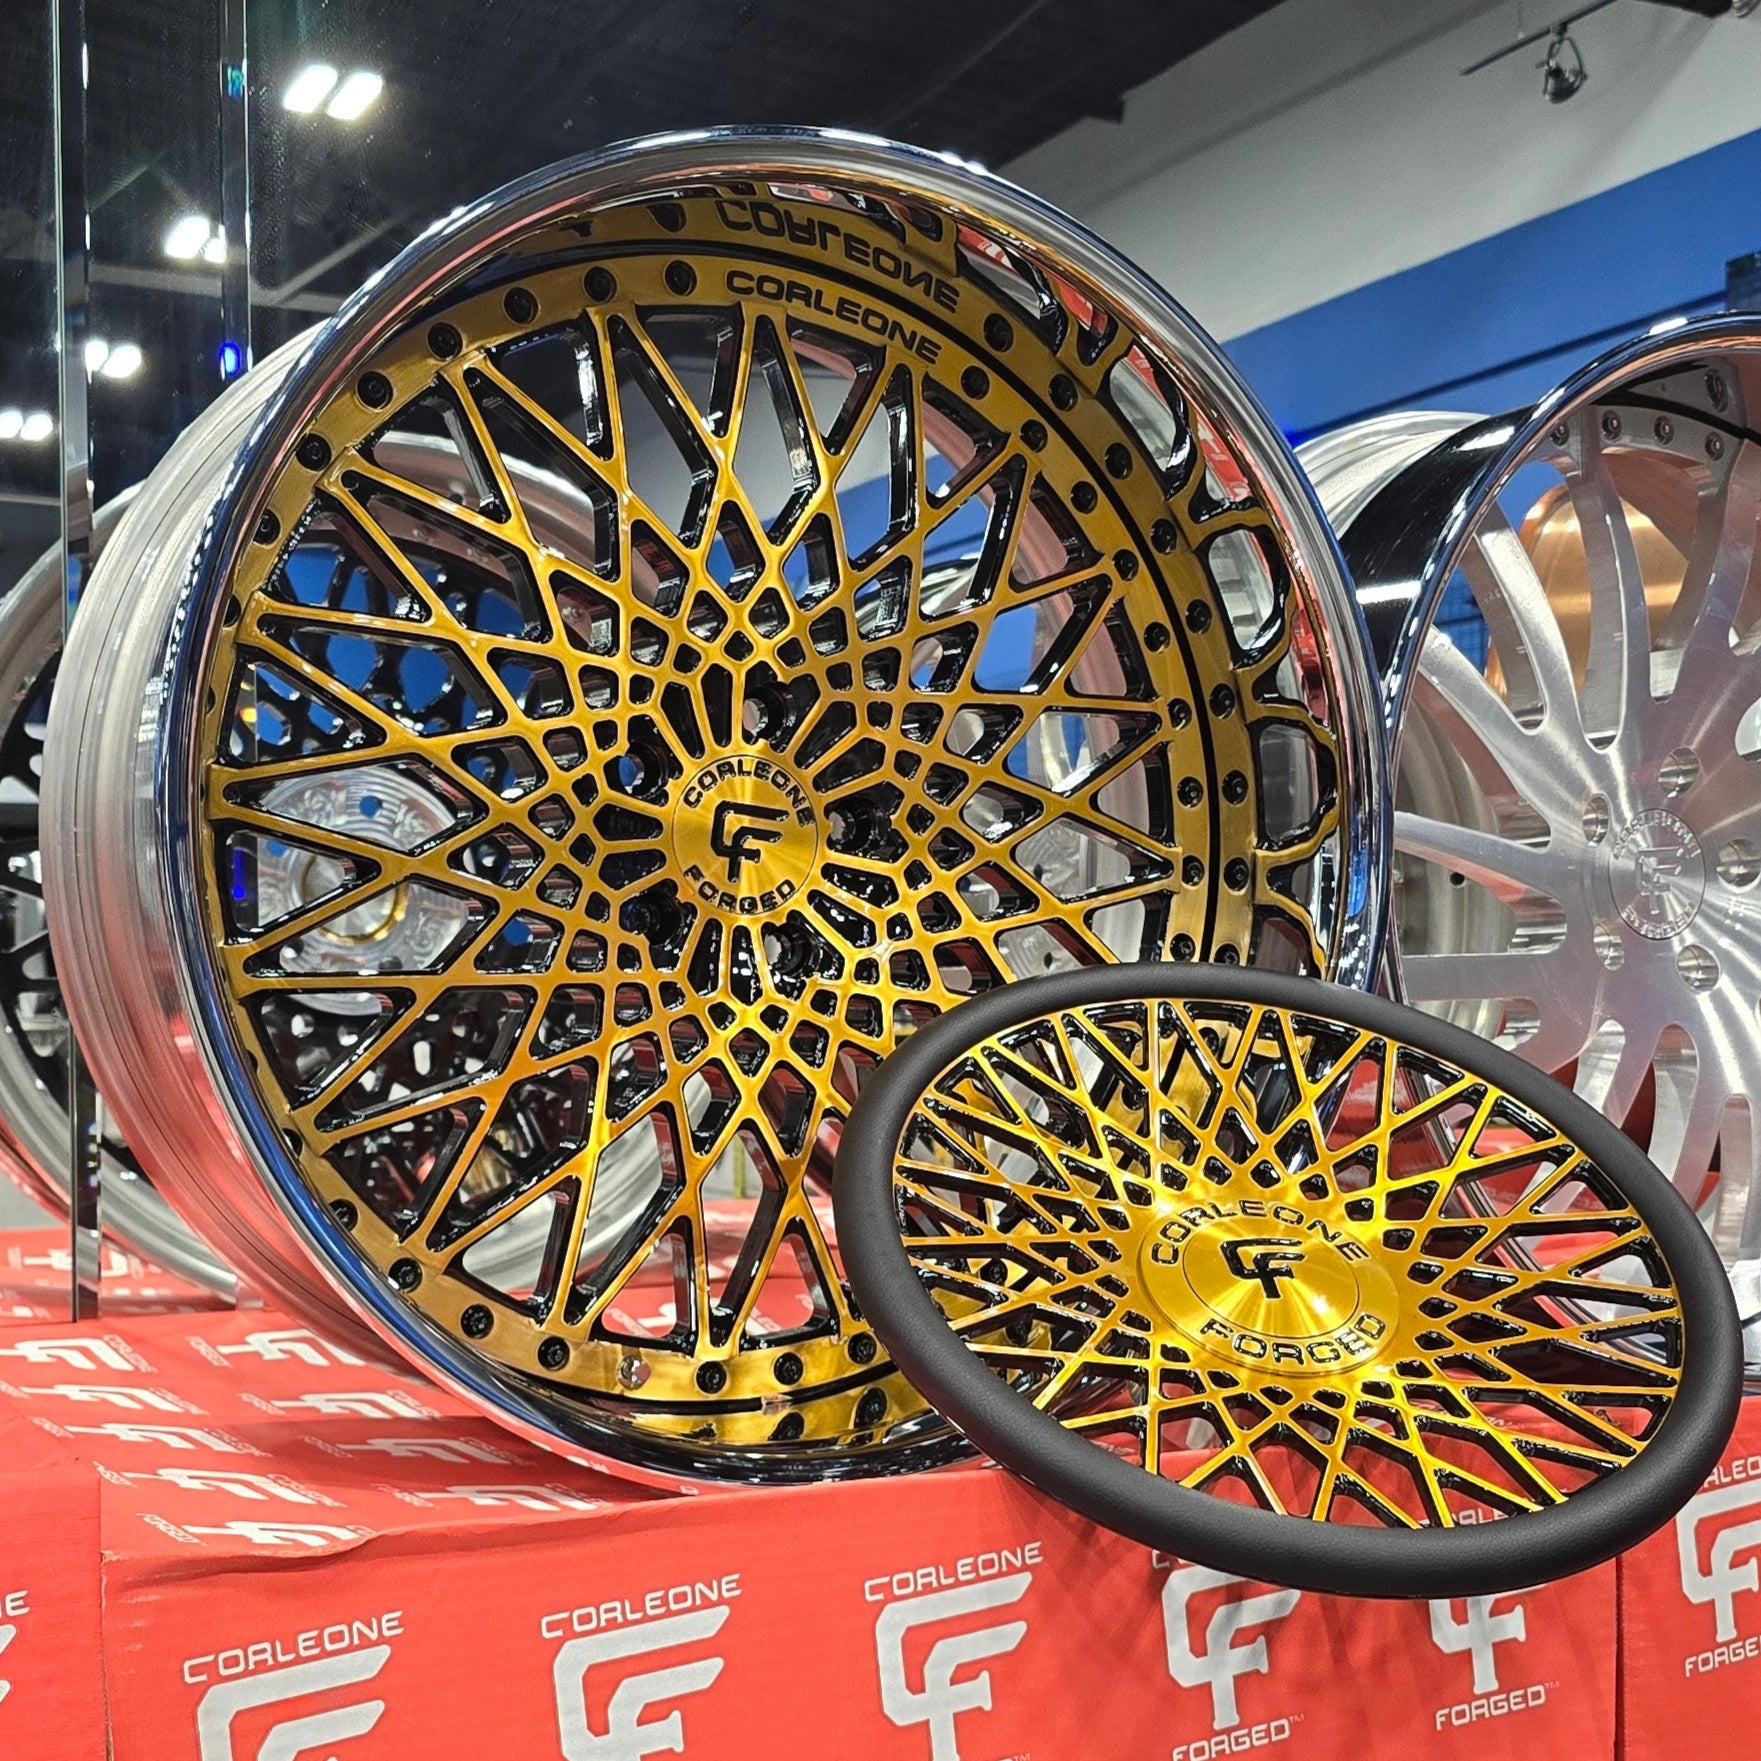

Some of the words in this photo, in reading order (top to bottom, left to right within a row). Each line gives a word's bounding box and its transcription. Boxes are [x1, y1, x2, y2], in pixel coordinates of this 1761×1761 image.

[726, 270, 942, 365] CORLEONE
[683, 758, 816, 828] CORLEONE
[683, 863, 797, 914] FORGED
[1150, 1199, 1370, 1265] CORLEONE
[1199, 1311, 1387, 1366] FORGED
[864, 1541, 1044, 1602] CORLEONE
[540, 1572, 742, 1639] CORLEONE
[182, 1610, 405, 1685] CORLEONE
[1684, 1635, 1761, 1678] FORGE
